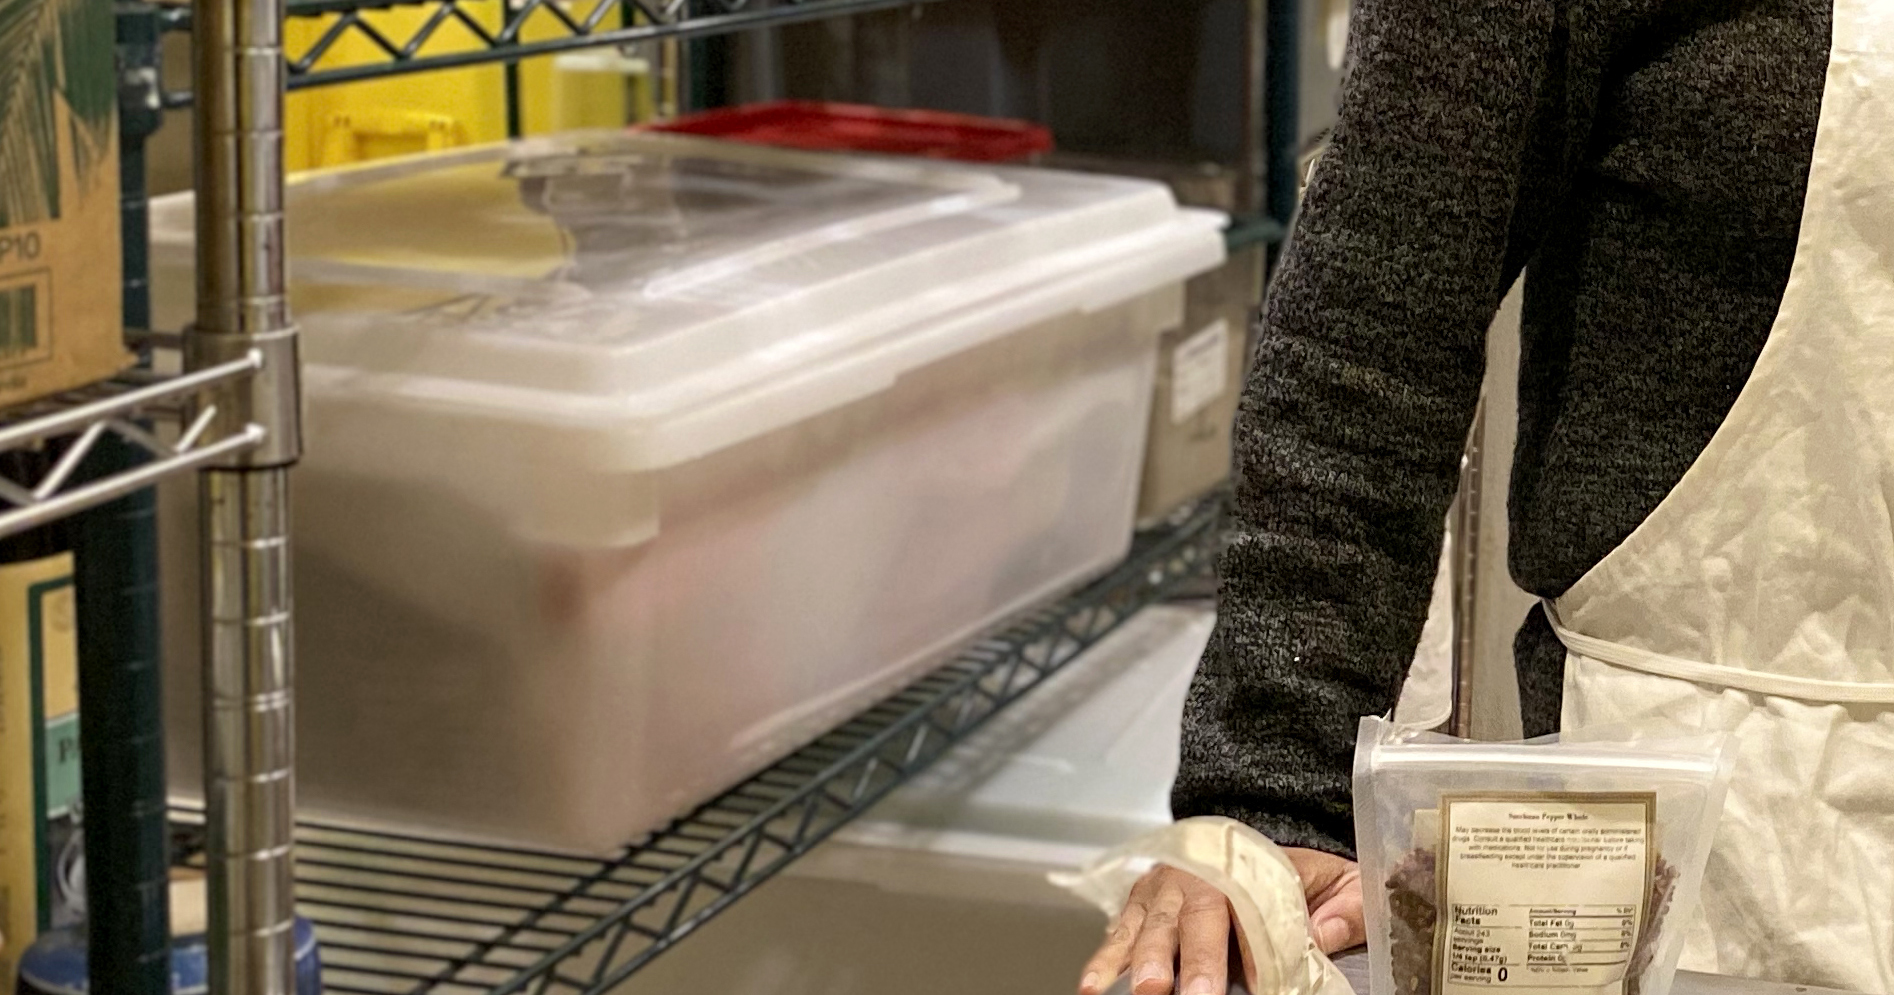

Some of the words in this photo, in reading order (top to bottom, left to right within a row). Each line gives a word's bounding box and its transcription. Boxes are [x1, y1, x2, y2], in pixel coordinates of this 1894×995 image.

[1454, 905, 1498, 916] Nutrition
[1454, 915, 1481, 925] Facts
[1529, 919, 1548, 927] Total
[1528, 930, 1559, 938] Sodium
[1452, 943, 1483, 954] Serving
[1451, 962, 1492, 974] Calories
[1497, 966, 1508, 982] 0
